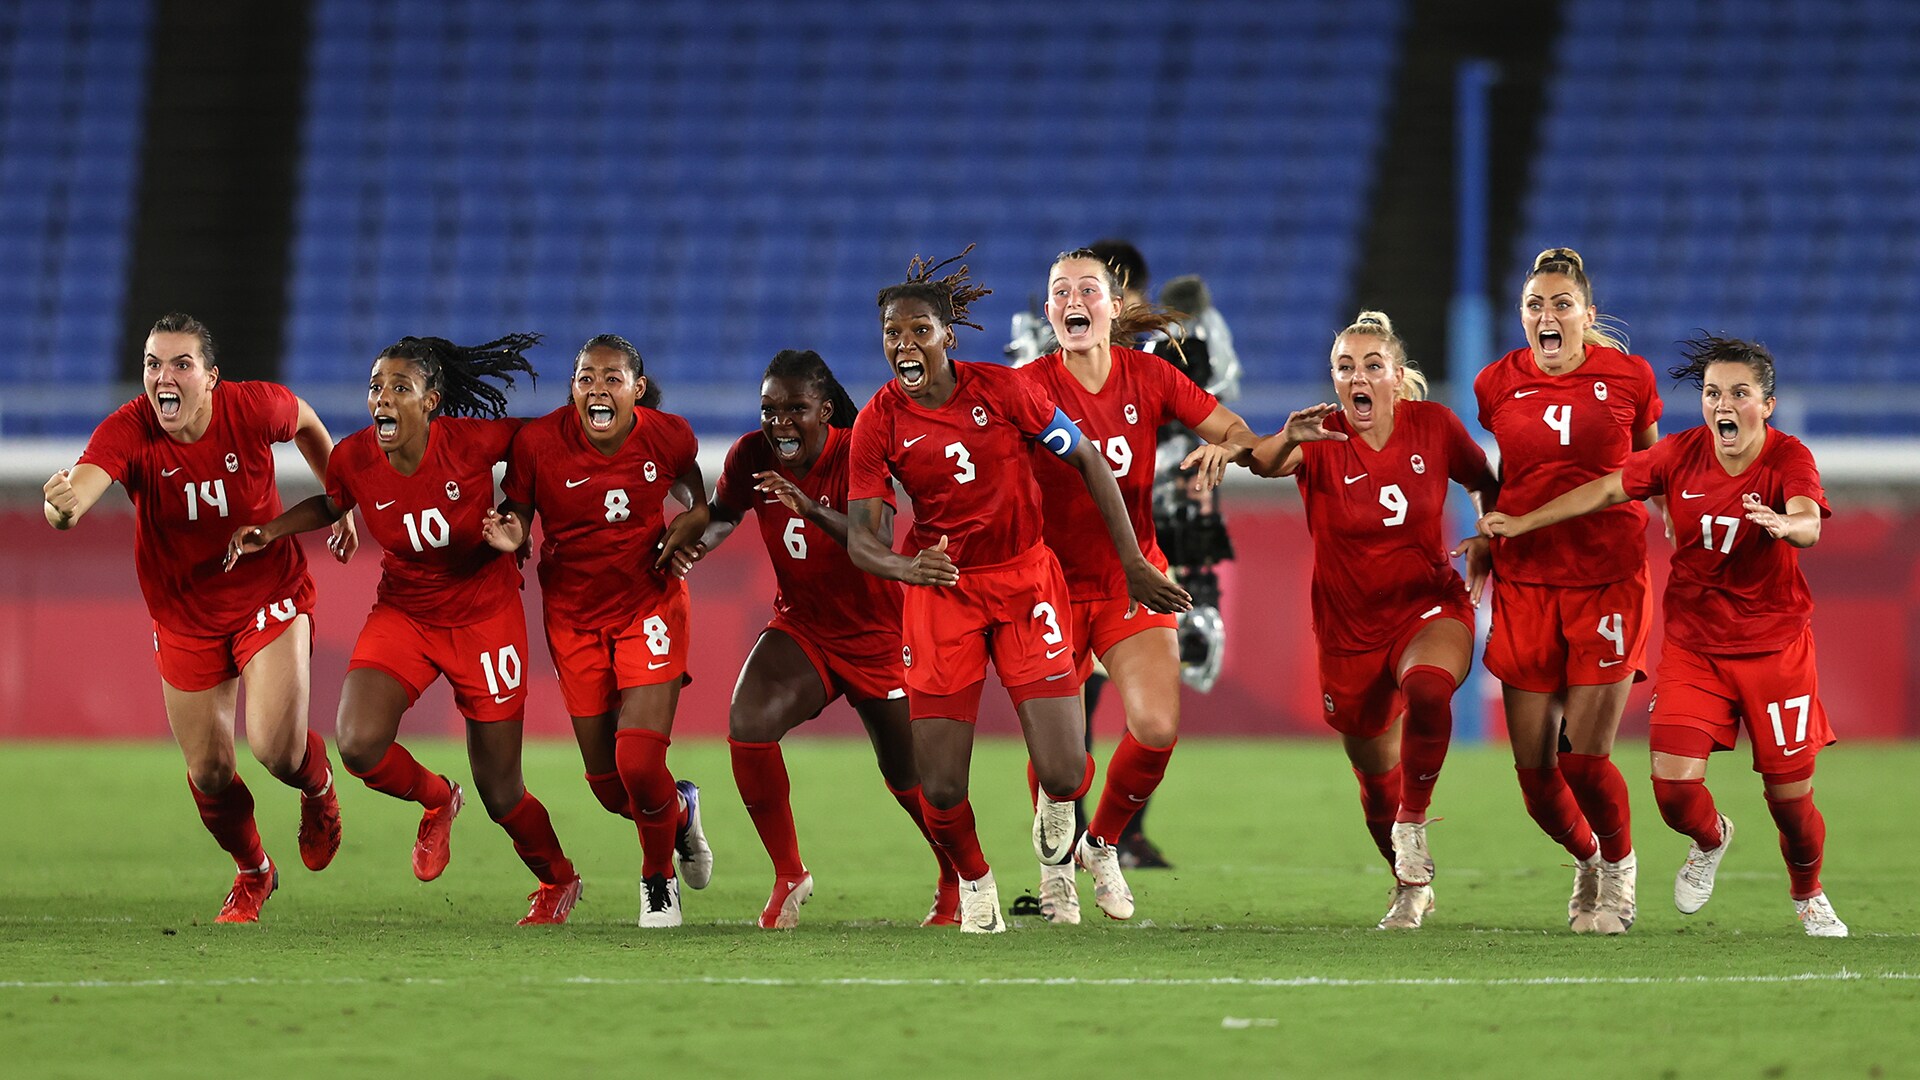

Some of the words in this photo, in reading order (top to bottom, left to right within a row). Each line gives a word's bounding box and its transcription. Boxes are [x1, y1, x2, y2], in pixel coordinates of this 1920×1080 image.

[1542, 404, 1573, 446] 4
[944, 441, 976, 485] 3
[183, 478, 229, 521] 14
[603, 488, 631, 522] 8
[1378, 483, 1409, 527] 9
[402, 507, 450, 552] 10
[782, 517, 807, 560] 6
[1699, 514, 1741, 555] 17
[643, 614, 671, 657] 8
[1032, 601, 1063, 645] 3
[1596, 613, 1625, 656] 4
[480, 644, 521, 693] 10
[1766, 694, 1811, 747] 17
